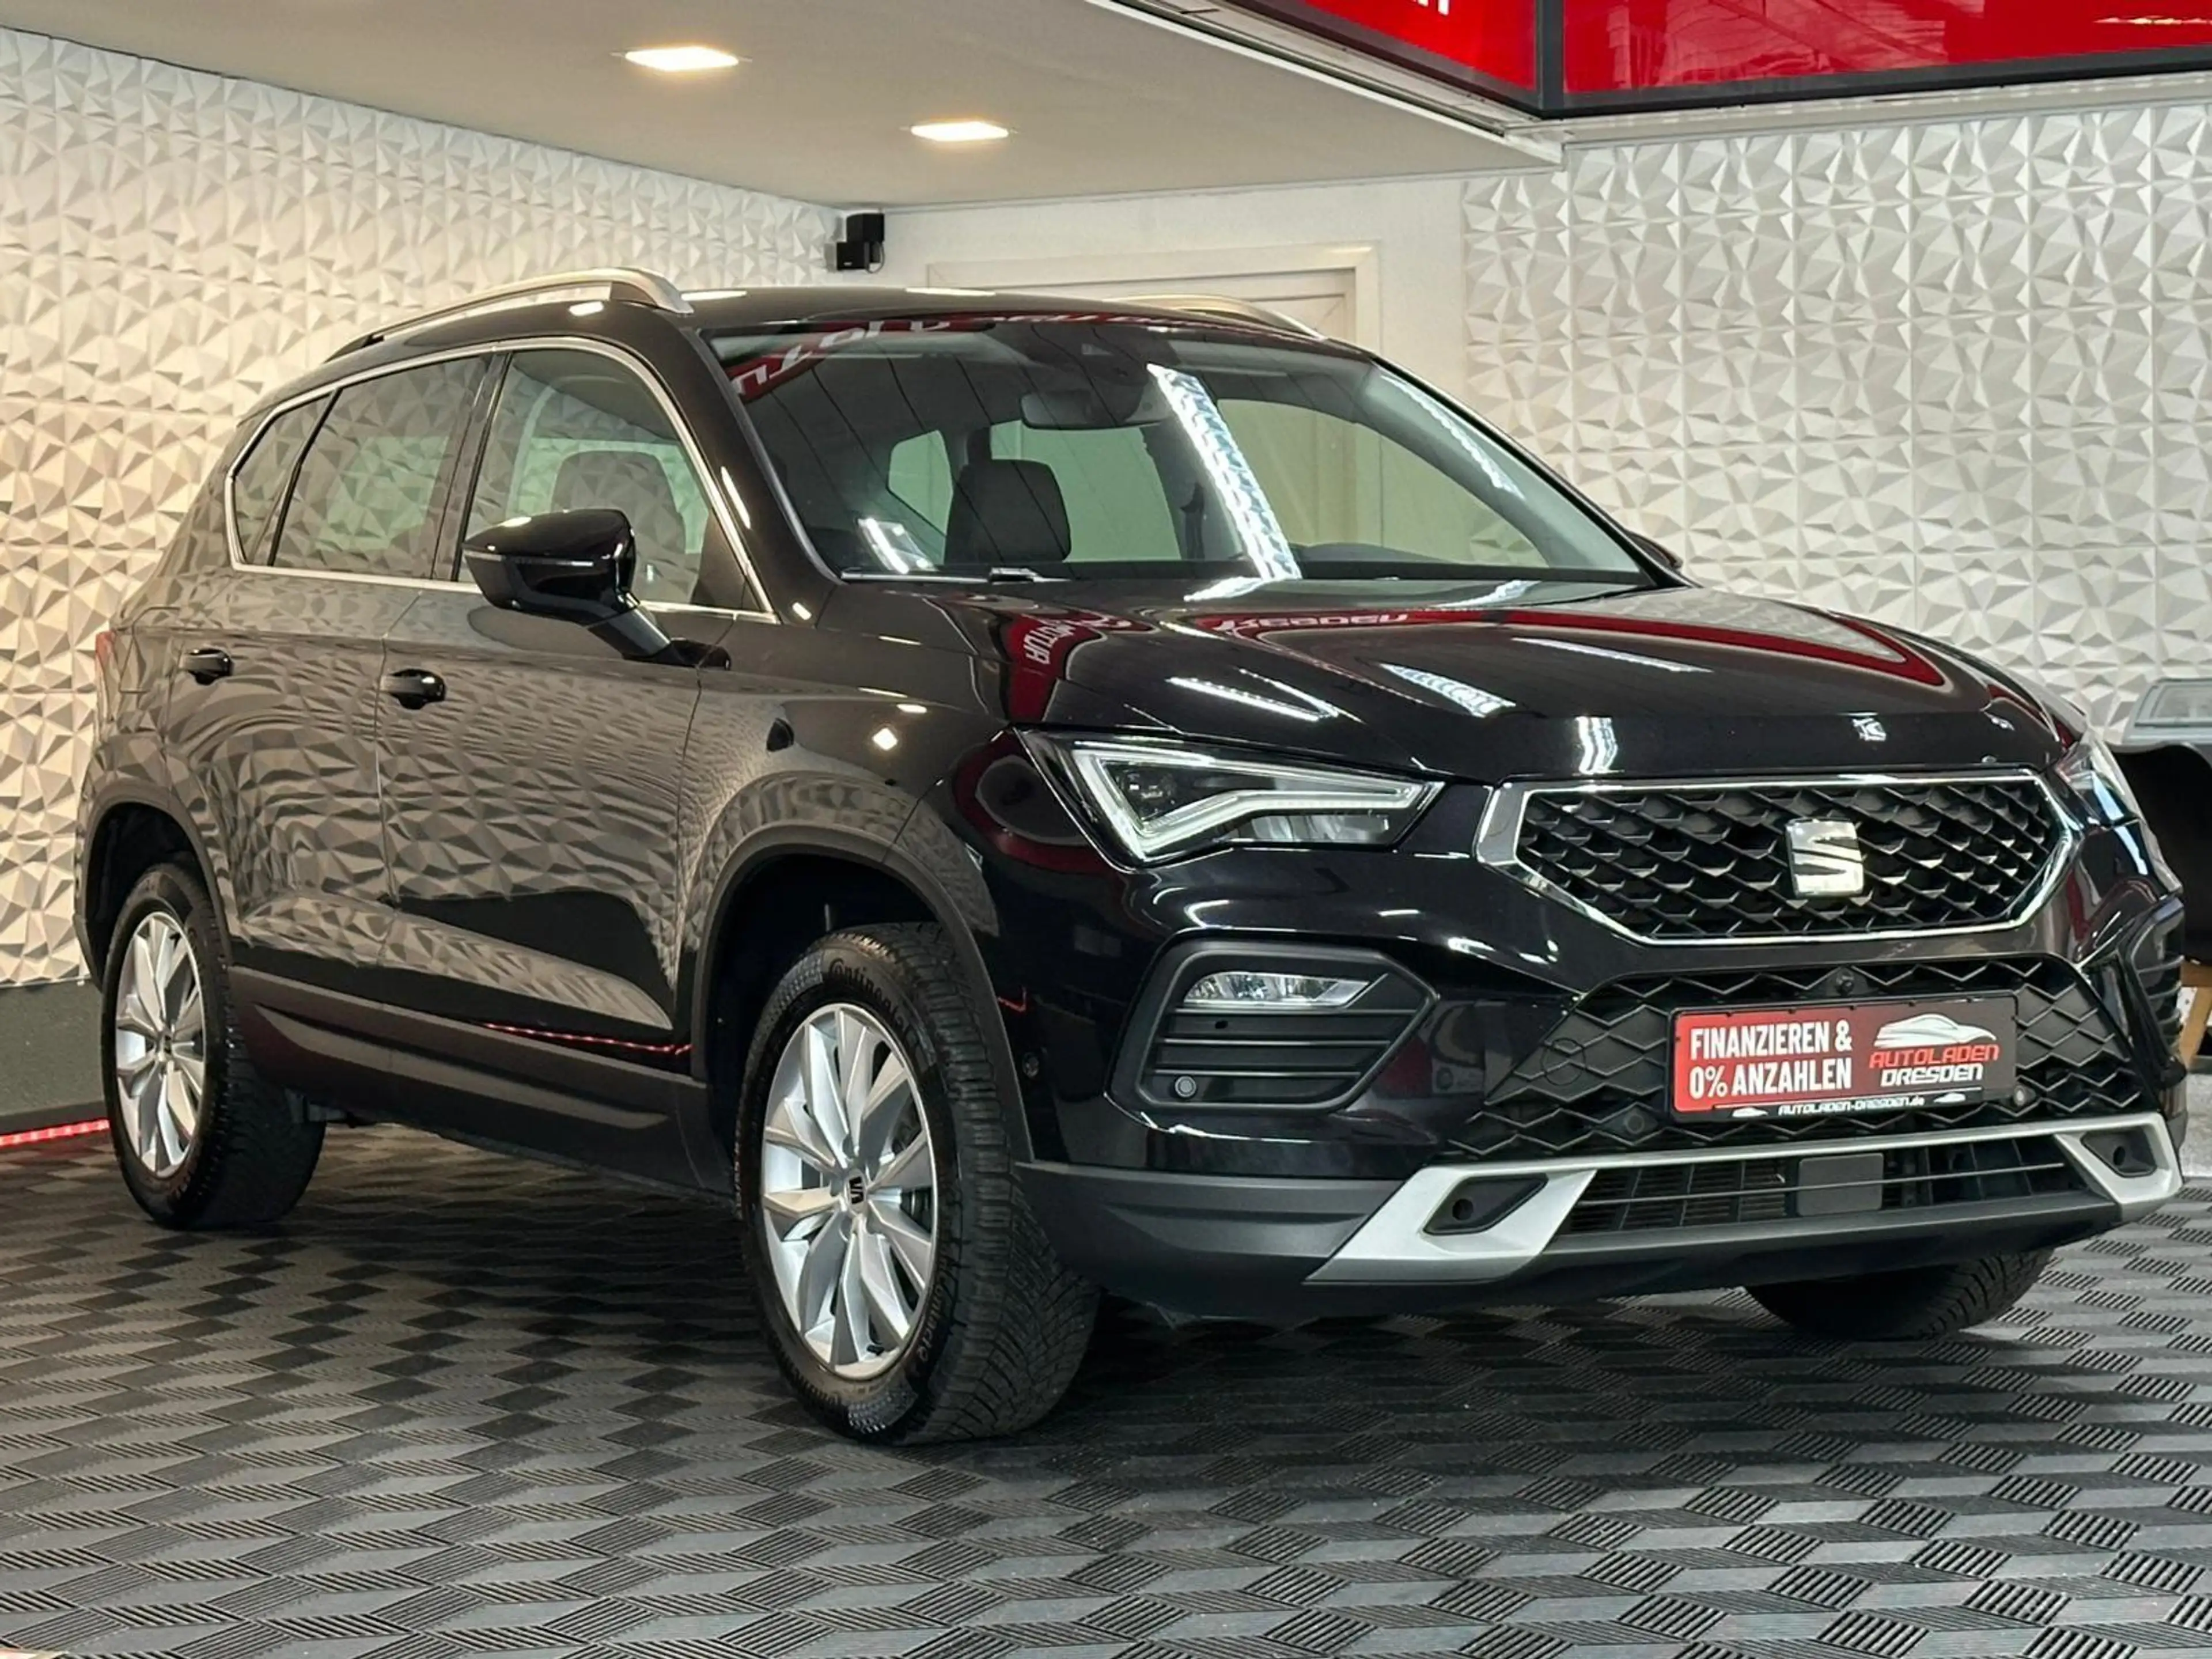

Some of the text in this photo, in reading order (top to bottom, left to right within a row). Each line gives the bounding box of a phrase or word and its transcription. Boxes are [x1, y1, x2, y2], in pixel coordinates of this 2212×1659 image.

[1690, 1019, 1853, 1060] FINANZIEREN &
[1868, 1044, 2001, 1069] AUTOLADEN
[1688, 1057, 1852, 1100] 0% ANZAHLEN
[1880, 1062, 1984, 1088] DRESDEN
